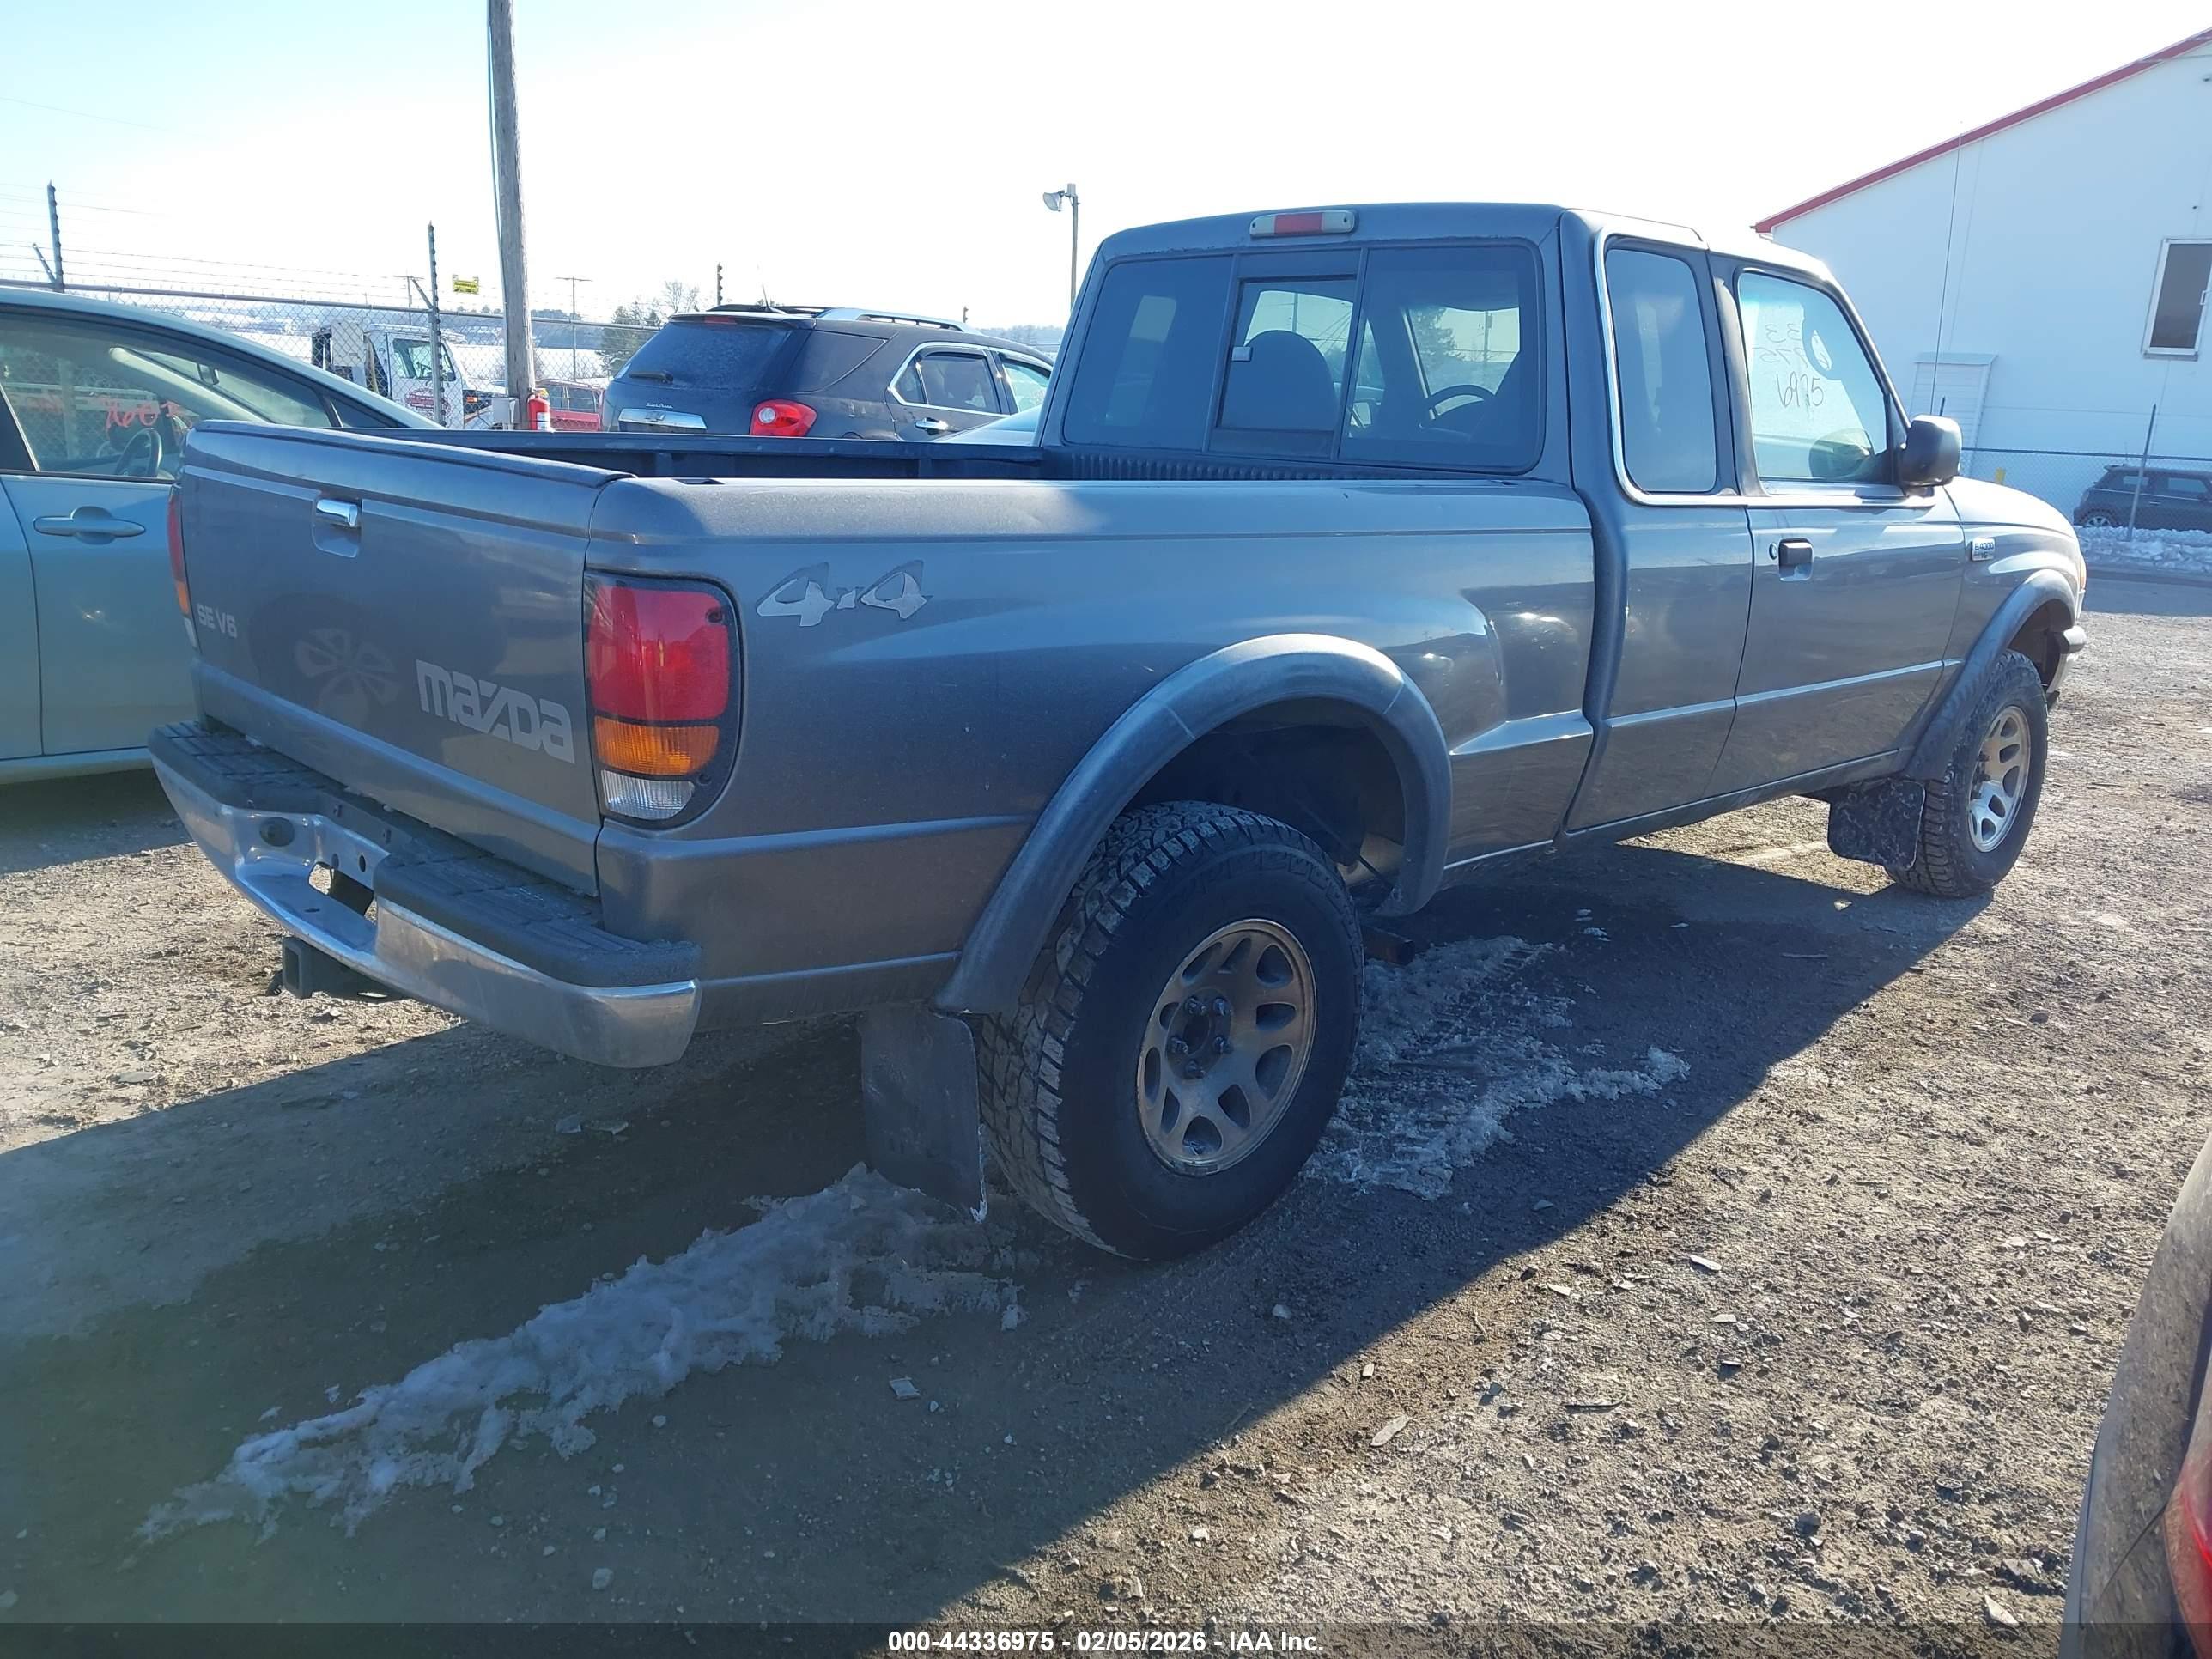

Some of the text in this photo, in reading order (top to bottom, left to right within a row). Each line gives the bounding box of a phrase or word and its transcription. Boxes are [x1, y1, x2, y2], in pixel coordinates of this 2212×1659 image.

[1776, 370, 1825, 408] 6975
[197, 603, 238, 639] SE V6
